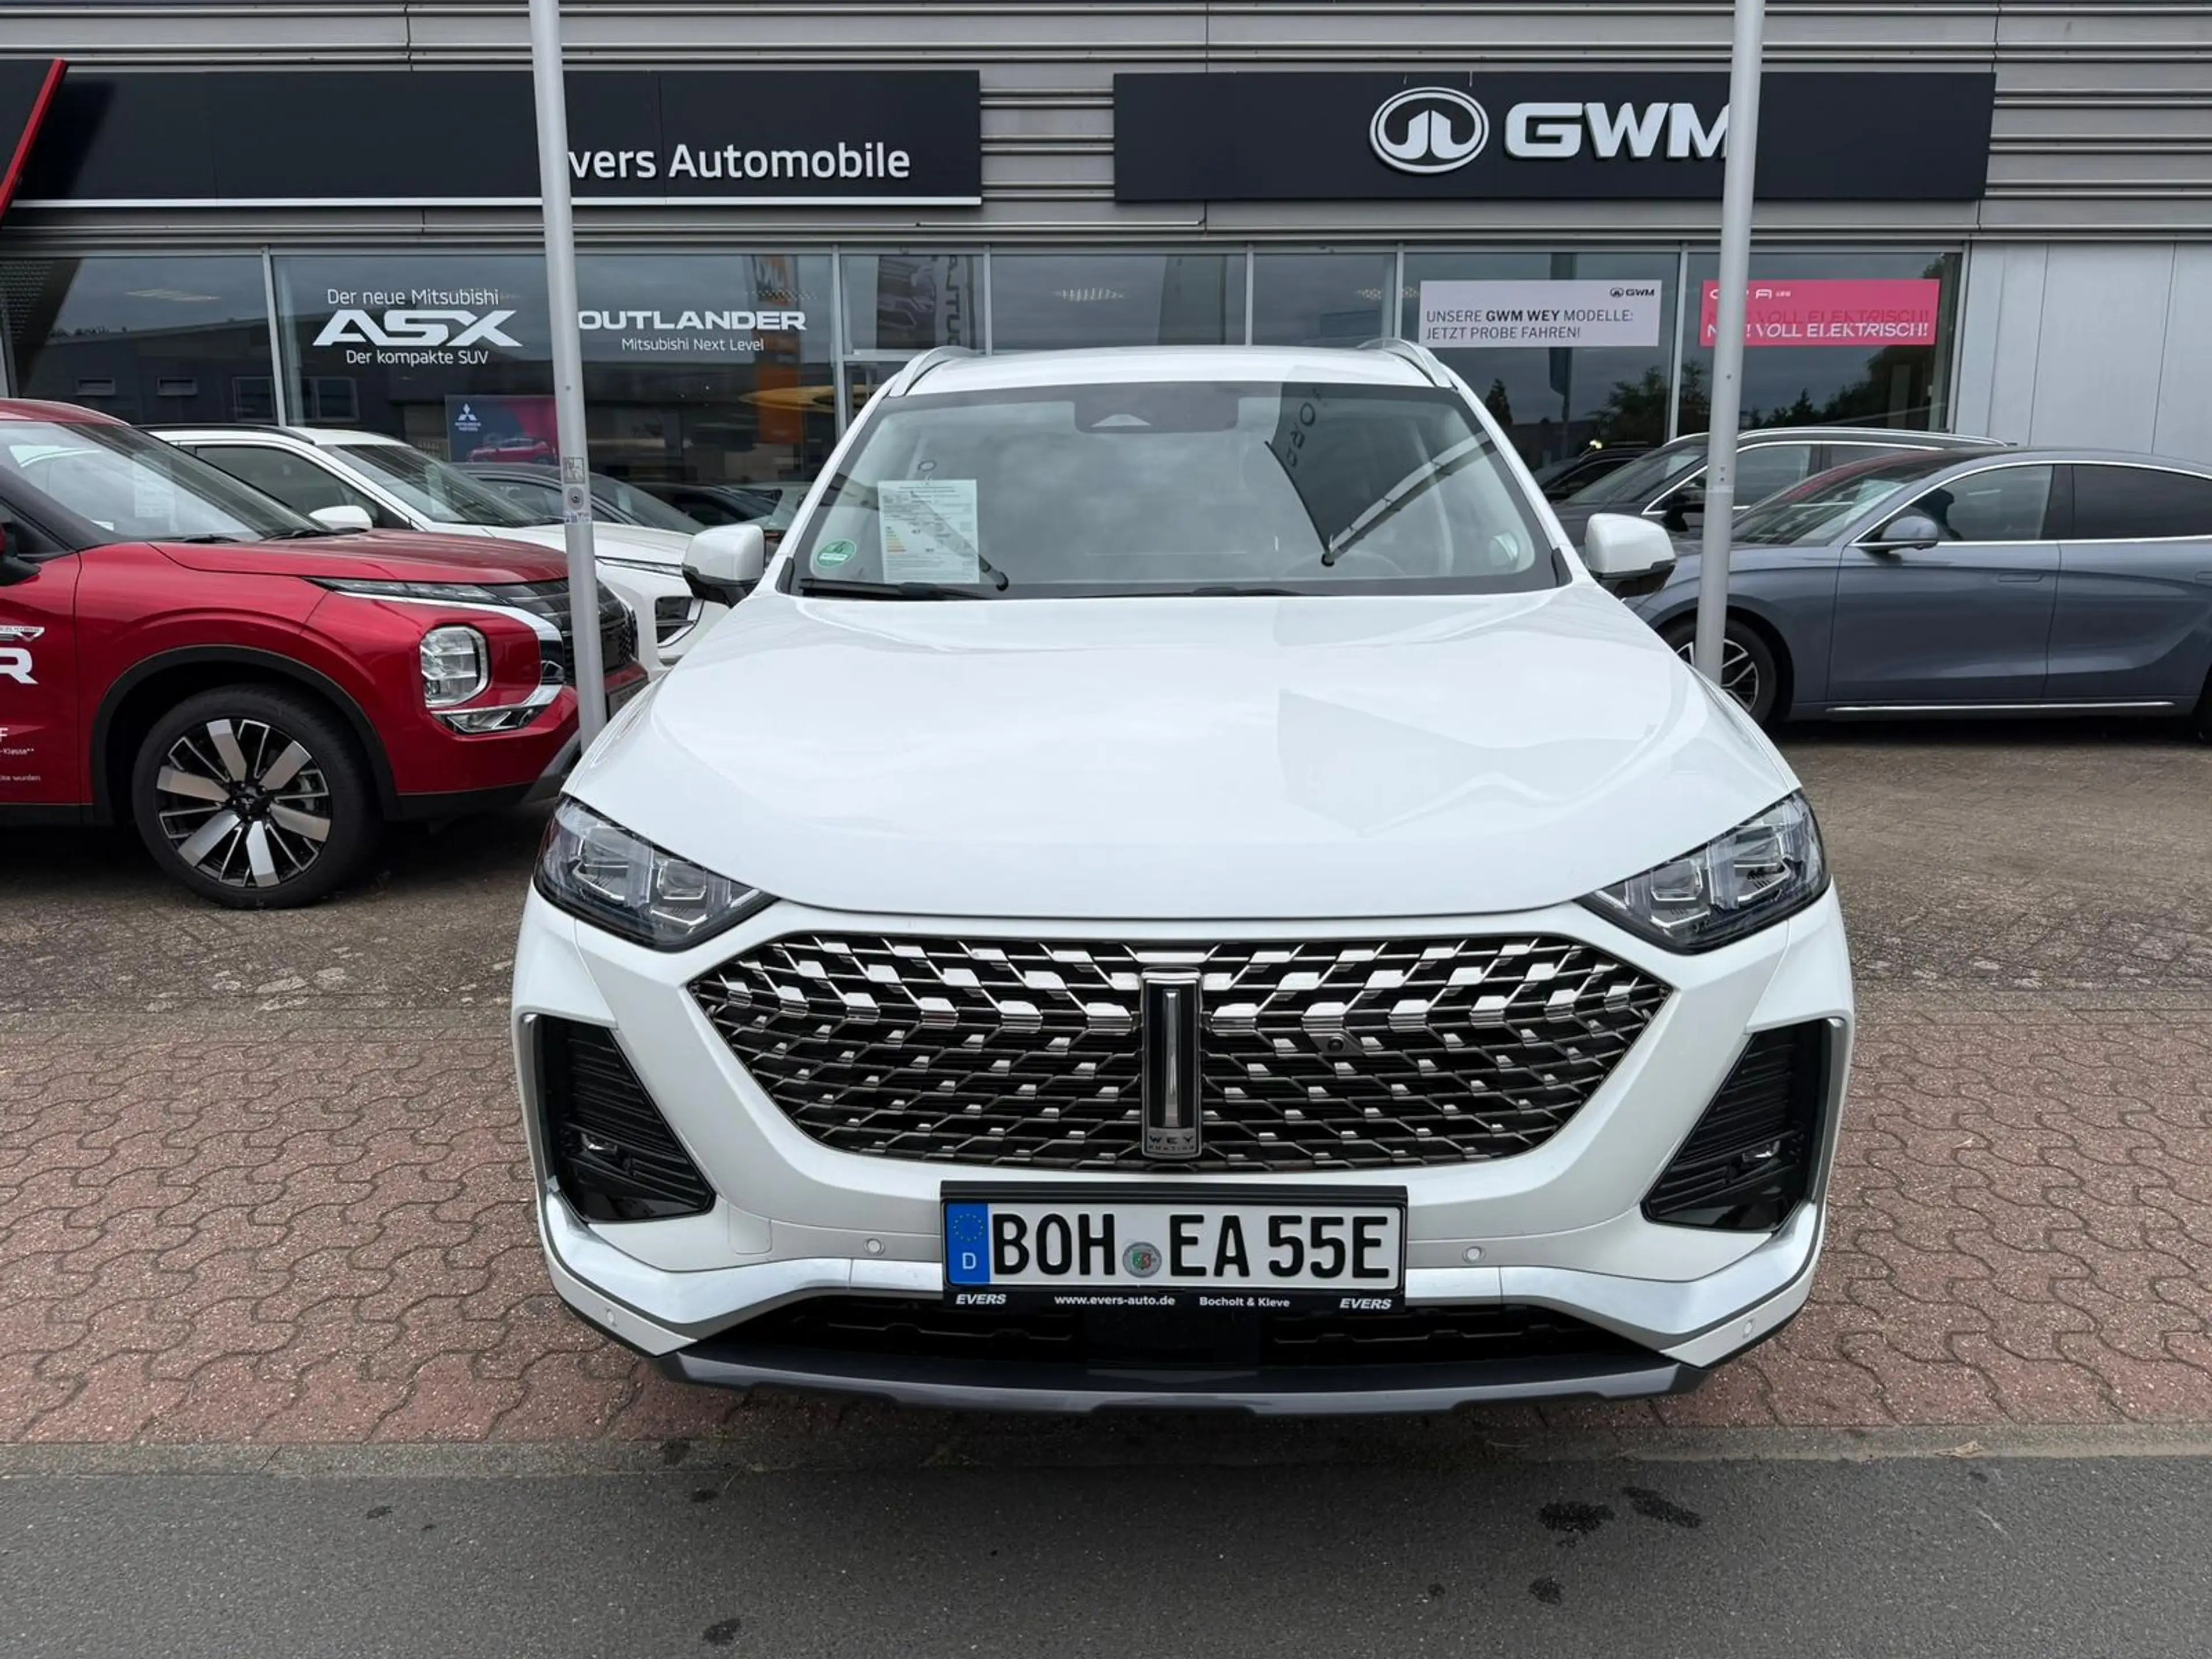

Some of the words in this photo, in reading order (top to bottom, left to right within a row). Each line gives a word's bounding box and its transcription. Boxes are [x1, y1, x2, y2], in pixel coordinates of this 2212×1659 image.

[1505, 102, 1730, 158] GWM
[567, 150, 657, 179] vers
[668, 142, 910, 178] Automobile
[327, 288, 358, 305] Der
[362, 290, 406, 305] neue
[411, 287, 499, 306] Mitsubishi
[1625, 289, 1655, 297] GWM
[577, 310, 808, 331] OUTLANDER
[1426, 309, 1483, 323] UNSERE
[1485, 309, 1524, 323] GWM
[1526, 309, 1560, 322] WEY
[1563, 309, 1634, 323] MODELLE:
[312, 309, 524, 347] ASX
[1426, 326, 1467, 340] JETZT
[1469, 325, 1518, 340] PROBE
[1520, 325, 1581, 339] FAHREN!
[1755, 323, 1804, 338] VOLL
[1806, 321, 1929, 338] ELEKTRISCH!
[621, 336, 690, 351] Mitsubishi
[693, 338, 726, 351] Next
[729, 337, 764, 352] Level
[346, 349, 373, 365] Der
[376, 349, 454, 368] kompakte
[457, 349, 490, 365] SUV
[1149, 1135, 1194, 1145] WEY
[992, 1213, 1116, 1276] BOH
[1169, 1214, 1251, 1278] EA
[1267, 1214, 1390, 1279] 55E
[961, 1251, 977, 1270] D
[955, 1293, 1007, 1305] EVERS
[1054, 1294, 1176, 1306] www.evers-auto.de
[1199, 1296, 1245, 1307] Bocholt
[1247, 1297, 1255, 1306] &
[1257, 1297, 1291, 1308] Kleve
[1339, 1297, 1392, 1310] EVERS
